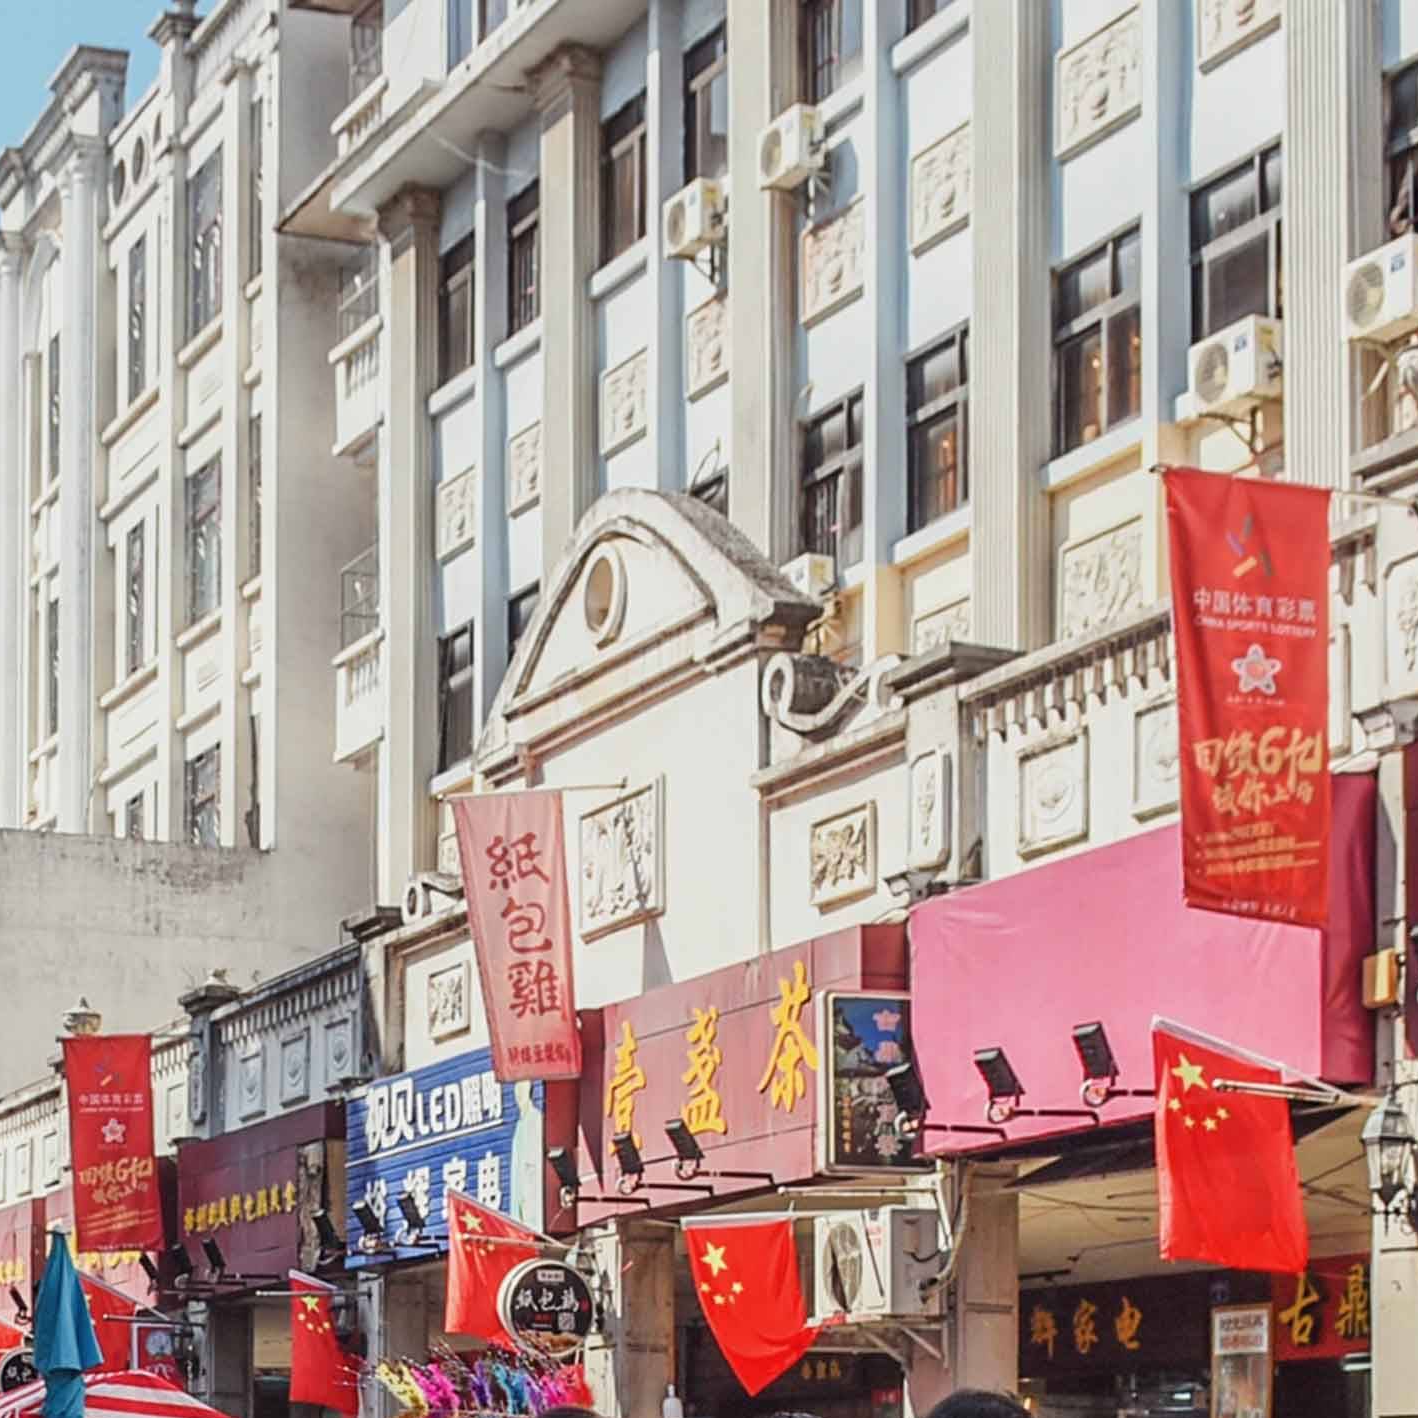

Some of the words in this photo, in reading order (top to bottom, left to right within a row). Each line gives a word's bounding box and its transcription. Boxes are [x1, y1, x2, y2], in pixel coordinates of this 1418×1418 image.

[1193, 586, 1317, 623] 中国体育彩票
[485, 831, 561, 1020] 紙包雞
